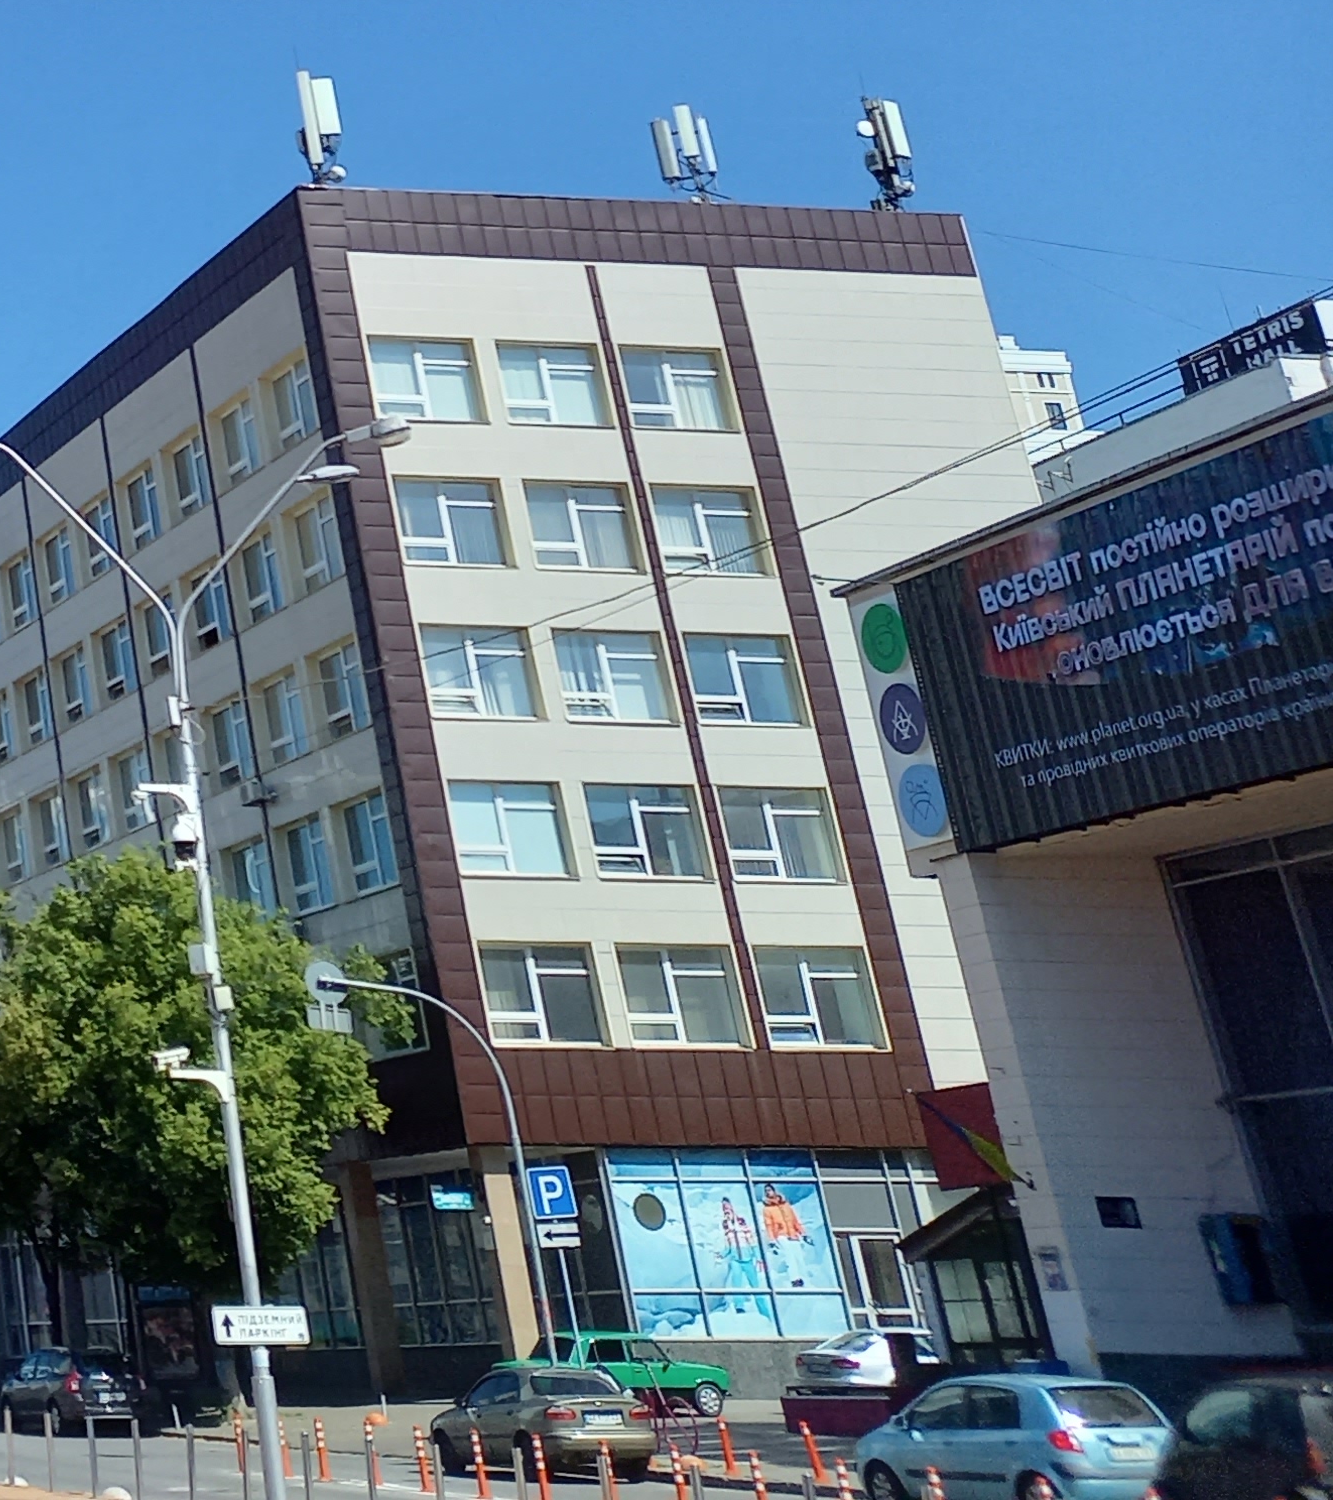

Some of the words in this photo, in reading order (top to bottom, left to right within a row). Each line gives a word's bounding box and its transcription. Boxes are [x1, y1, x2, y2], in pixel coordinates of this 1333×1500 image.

[1228, 310, 1305, 355] TETRIS
[1245, 339, 1303, 370] HALL
[978, 553, 1082, 615] ВСЕСВІТ
[1090, 514, 1207, 575] постійно
[538, 1175, 563, 1214] P
[239, 1328, 287, 1338] ПАРКІНГ
